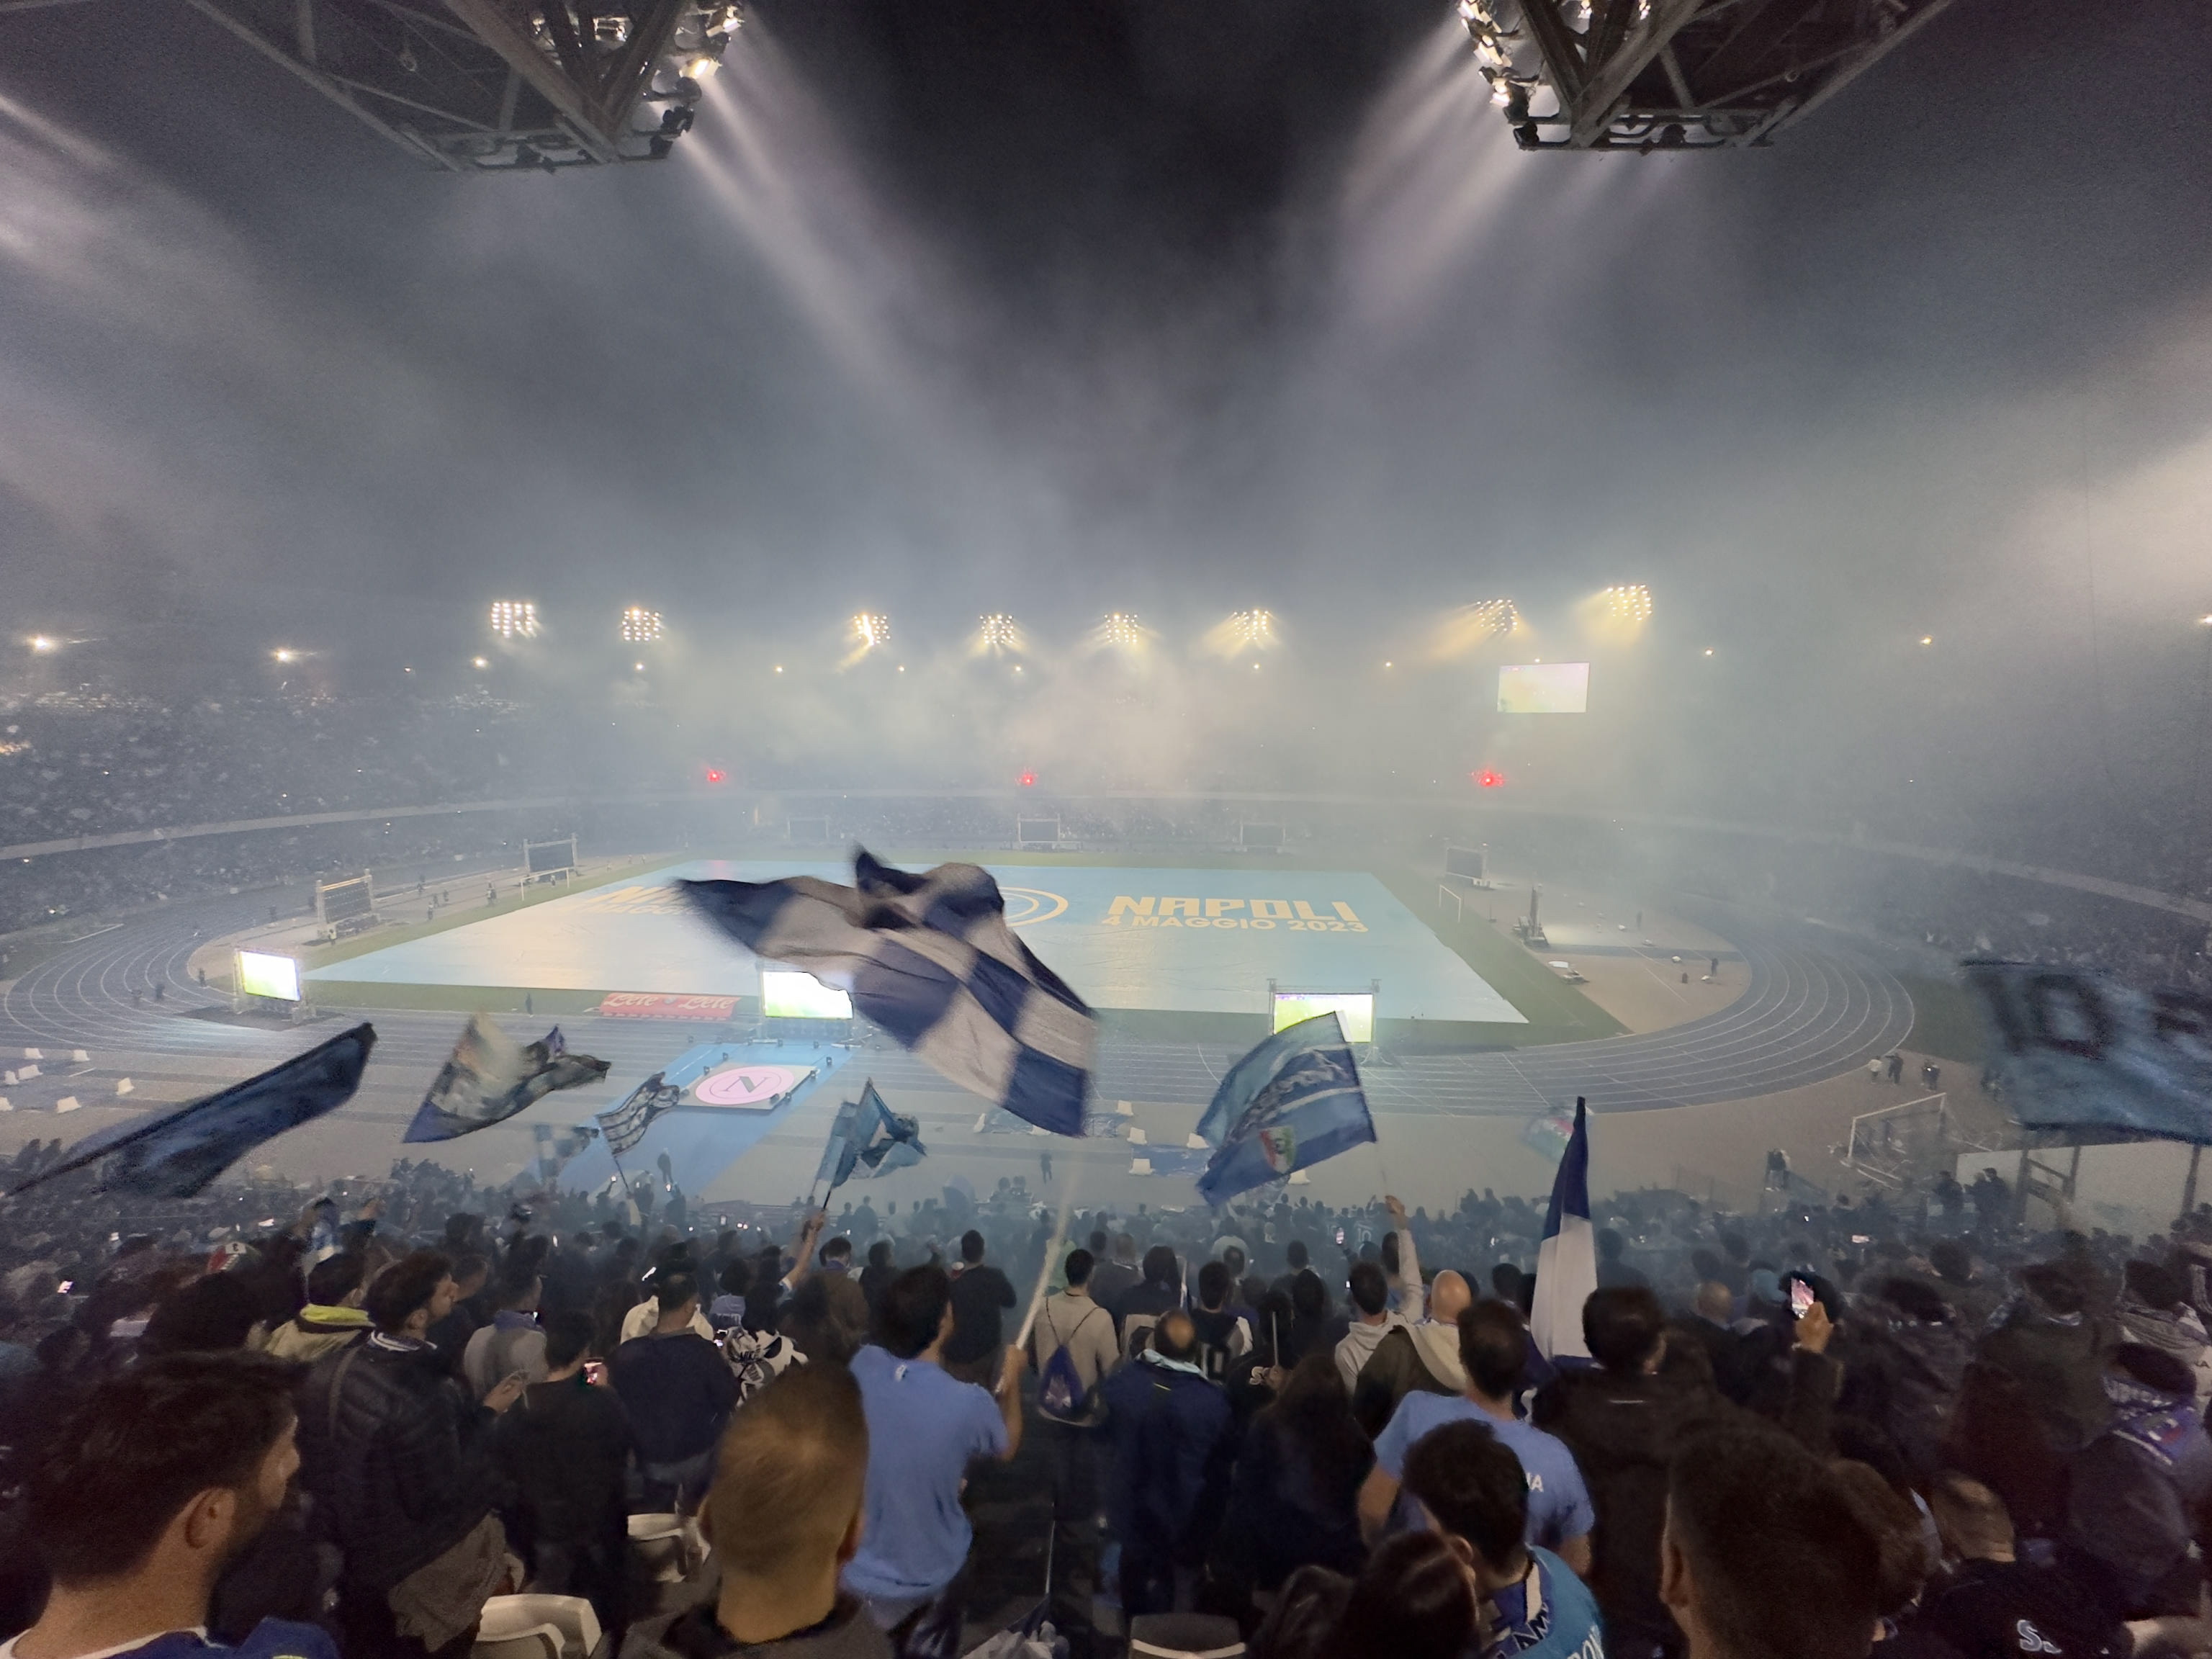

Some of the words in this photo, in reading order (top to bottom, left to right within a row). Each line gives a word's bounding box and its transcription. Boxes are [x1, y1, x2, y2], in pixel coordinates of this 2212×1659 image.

[1107, 895, 1360, 921] NAPOLI
[1101, 915, 1122, 925] 4
[1131, 916, 1283, 930] MAGGIO
[1288, 920, 1368, 932] 2023
[603, 995, 658, 1007] Lete
[678, 997, 737, 1010] Lete
[721, 1076, 772, 1093] N
